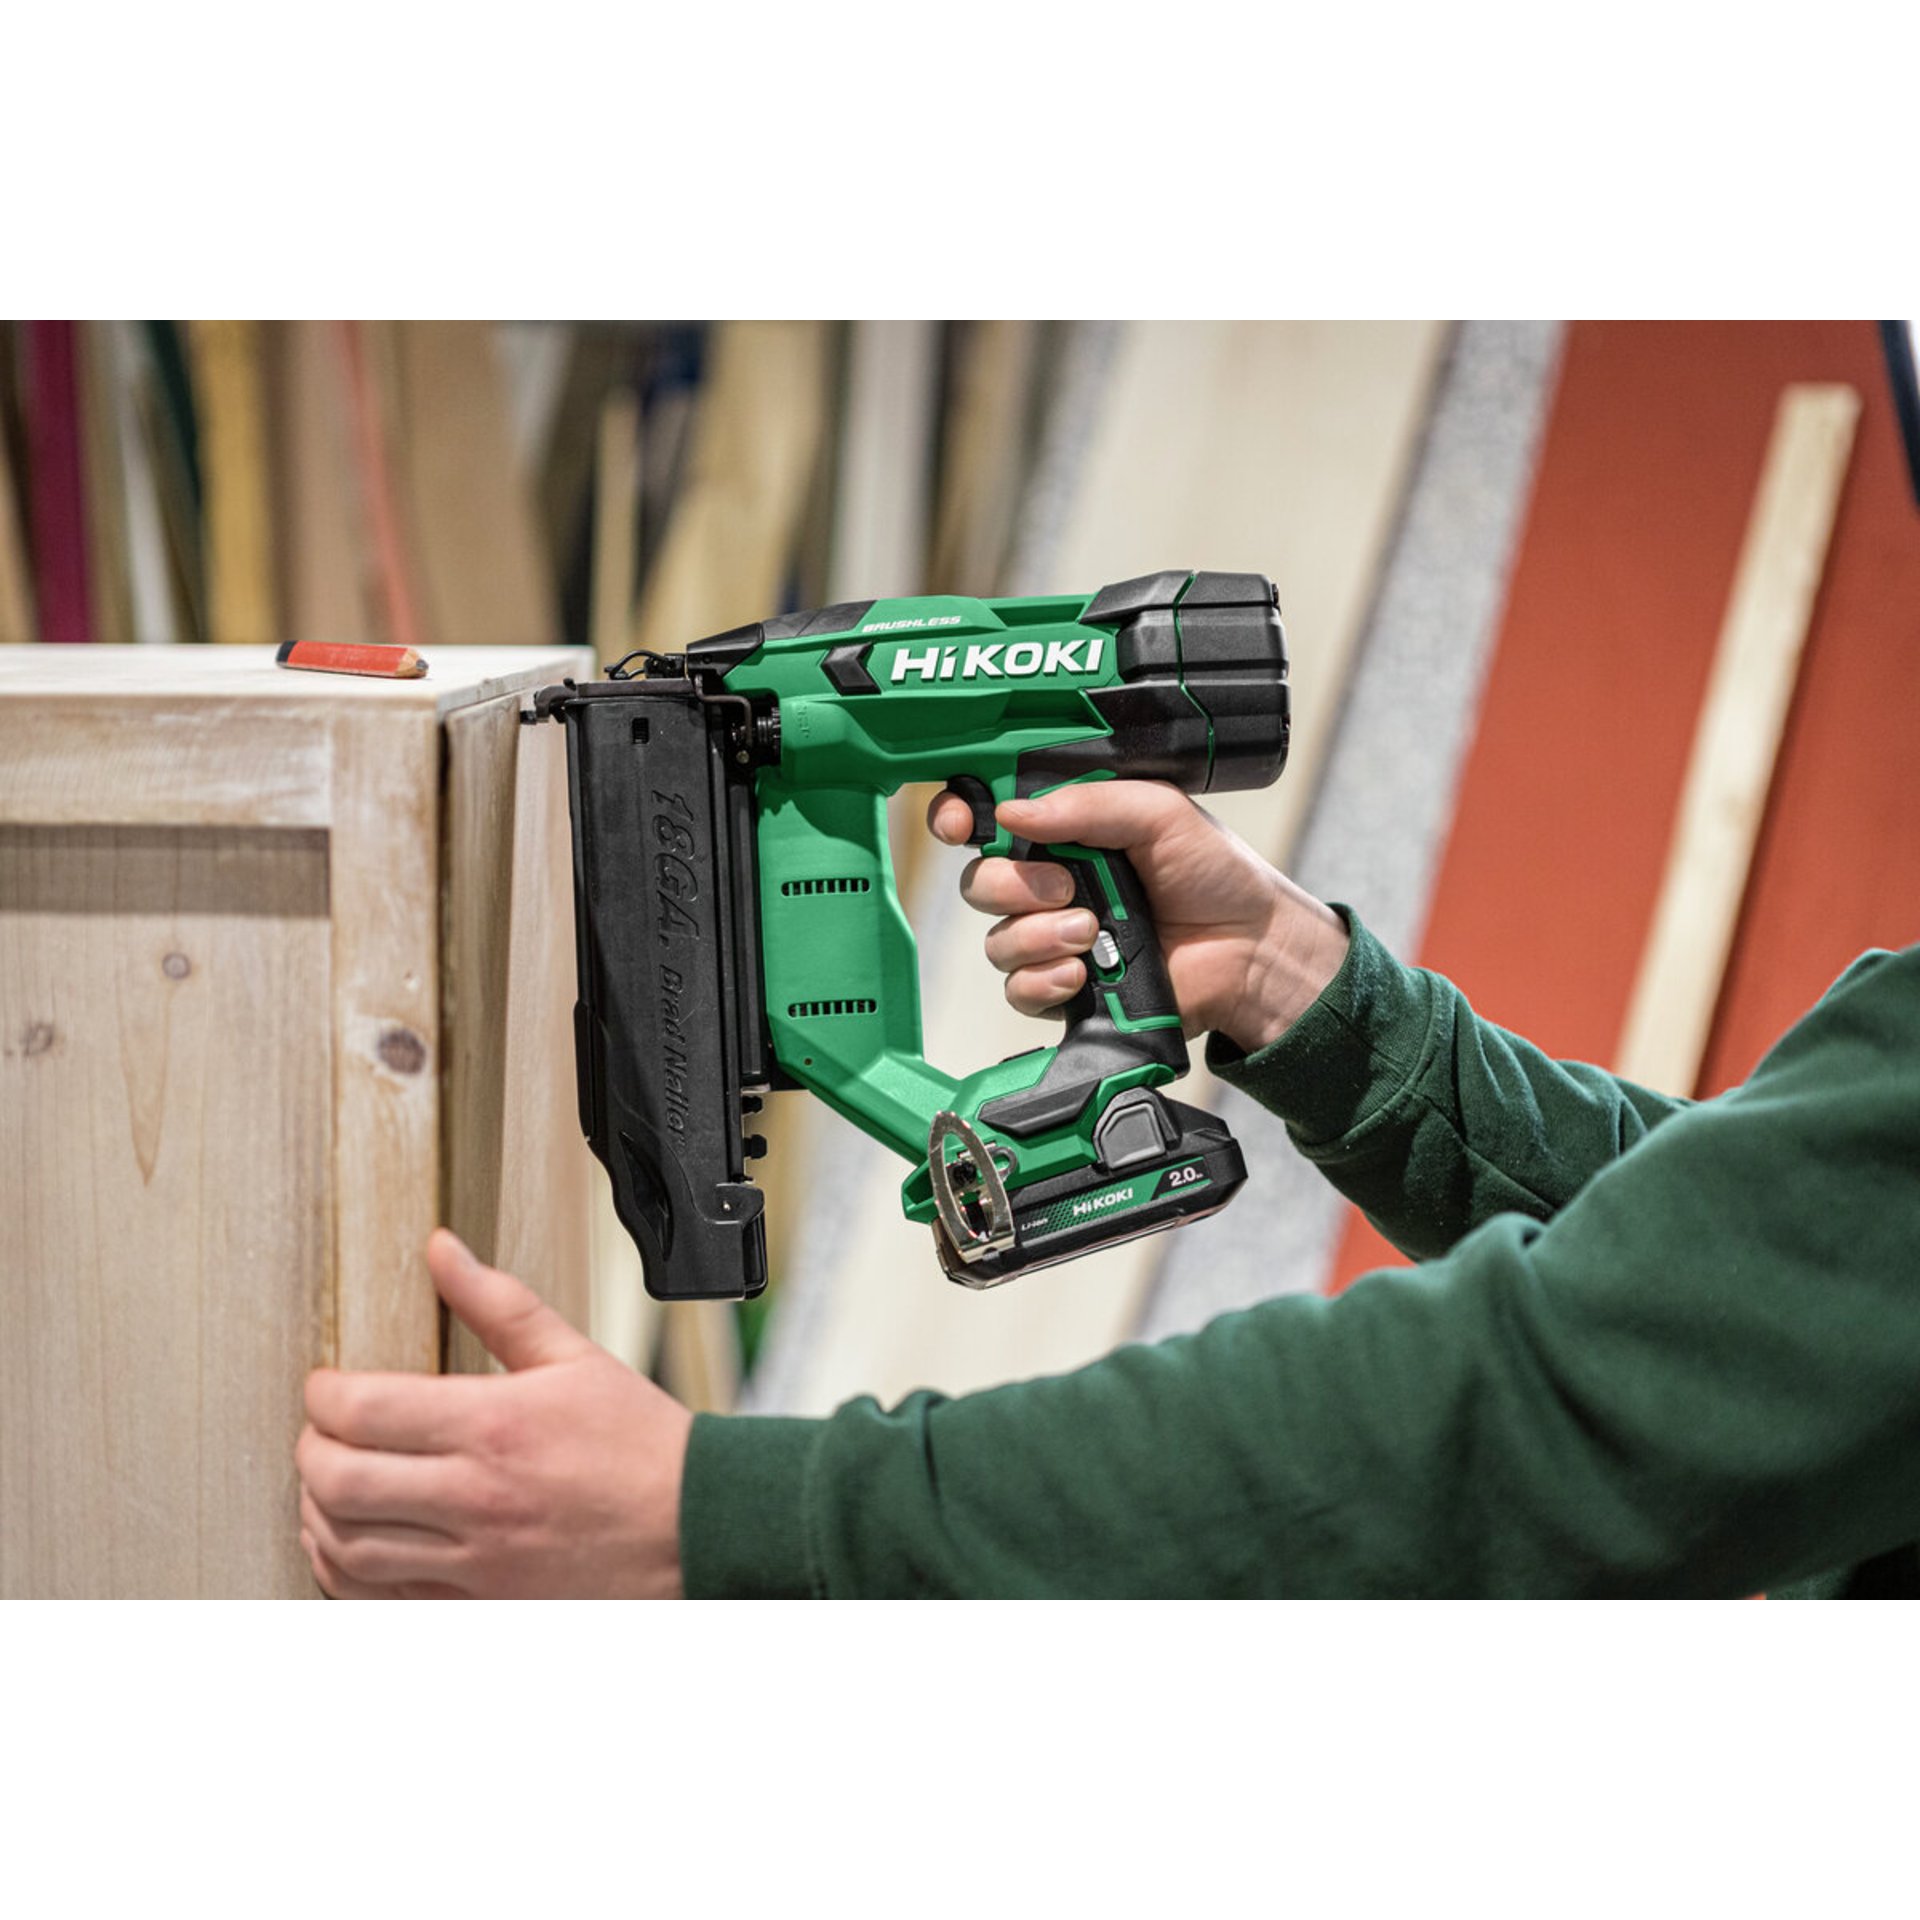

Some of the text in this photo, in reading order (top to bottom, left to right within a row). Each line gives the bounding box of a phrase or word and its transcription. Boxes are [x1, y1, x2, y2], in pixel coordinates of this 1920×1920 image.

[862, 615, 961, 633] BRUSHLESS
[659, 963, 685, 1044] Brad
[664, 1045, 688, 1147] Nailer
